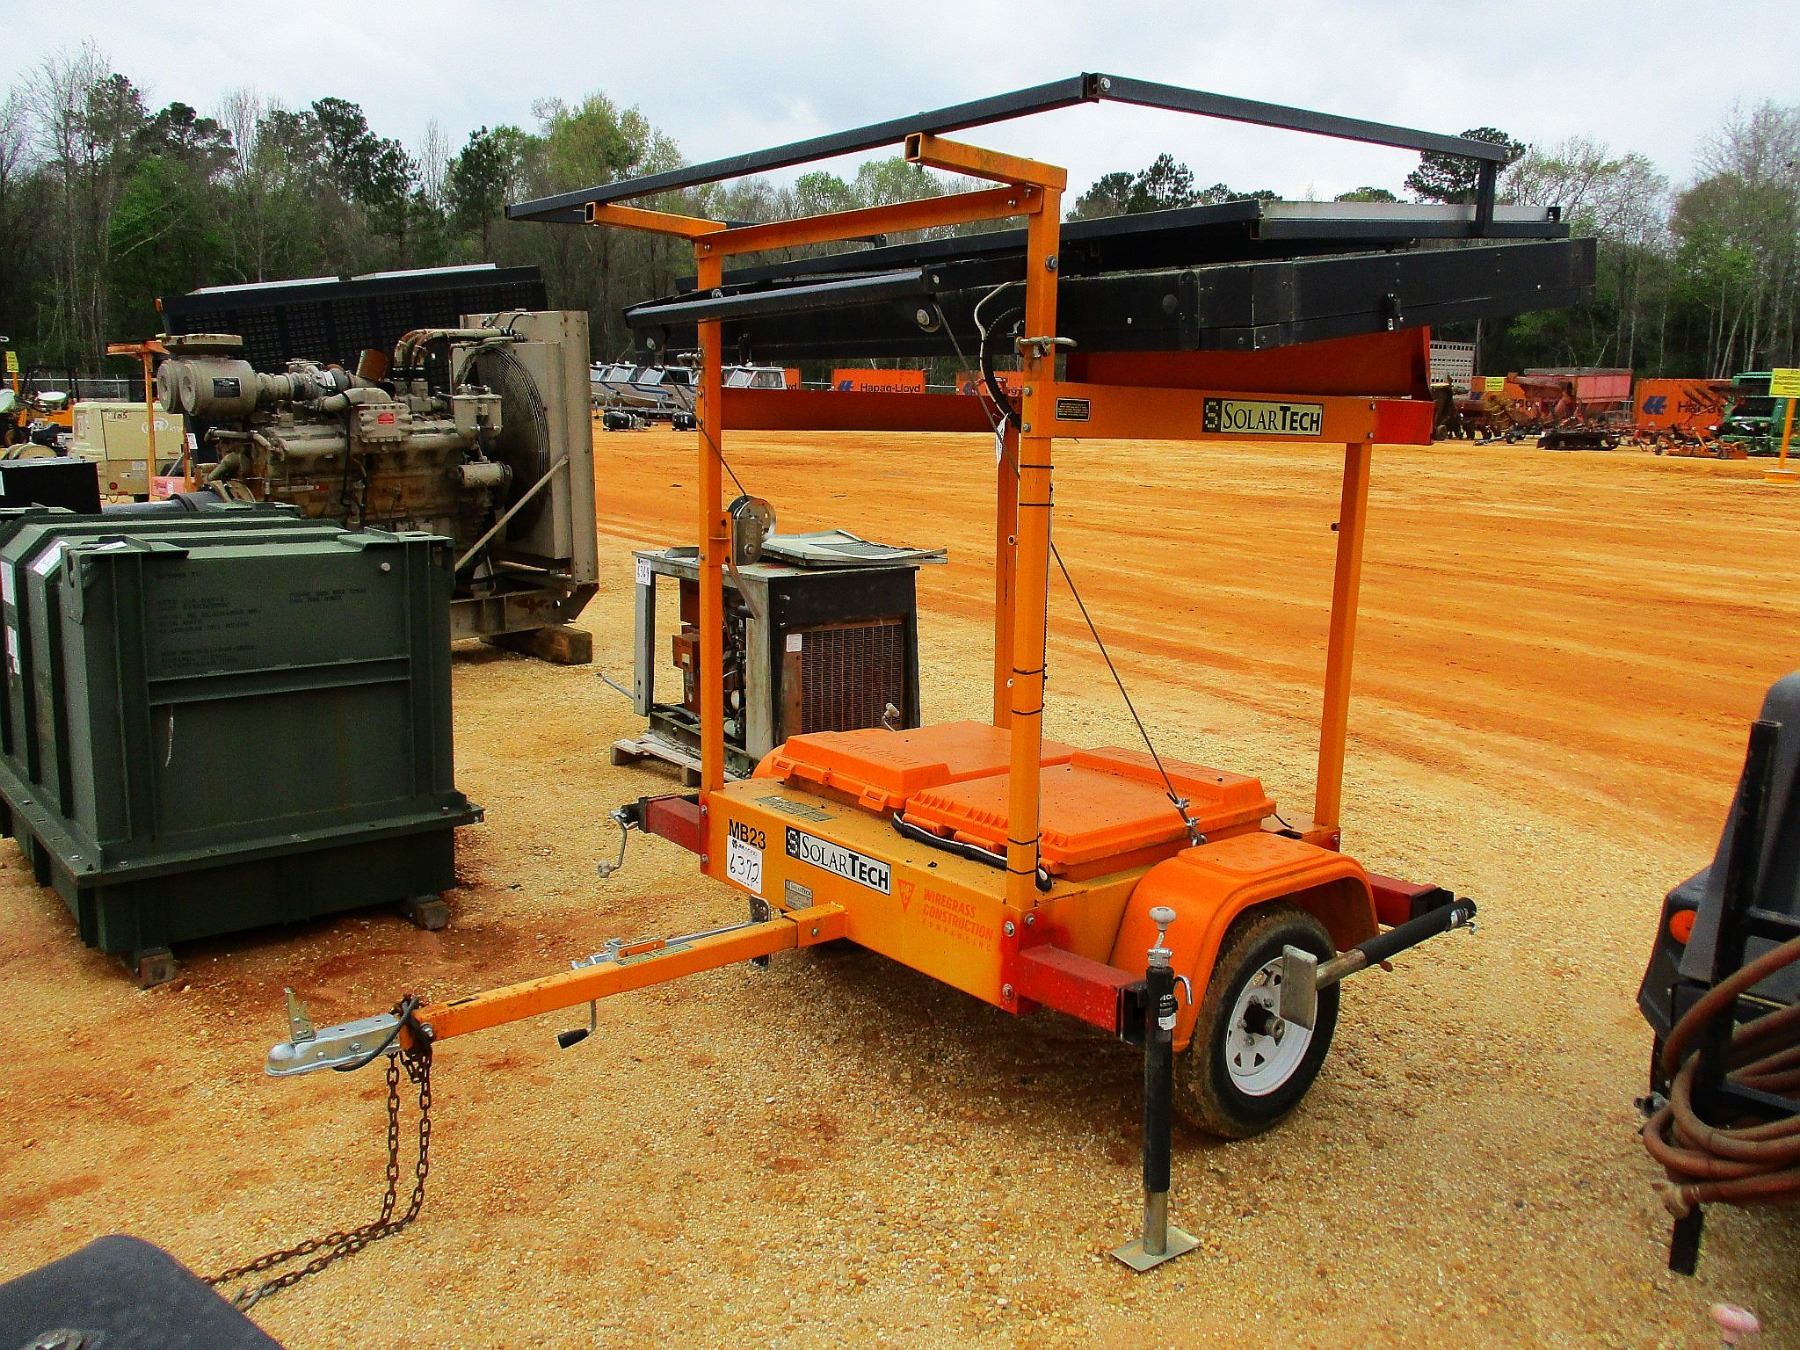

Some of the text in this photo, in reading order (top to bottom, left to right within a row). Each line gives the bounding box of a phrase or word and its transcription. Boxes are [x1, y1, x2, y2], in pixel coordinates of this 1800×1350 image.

[729, 819, 766, 849] MB23
[730, 853, 760, 883] 6372
[802, 835, 888, 891] SOLARTECH
[924, 888, 976, 918] WIREGRASS
[923, 904, 994, 940] CONSTRUCTION
